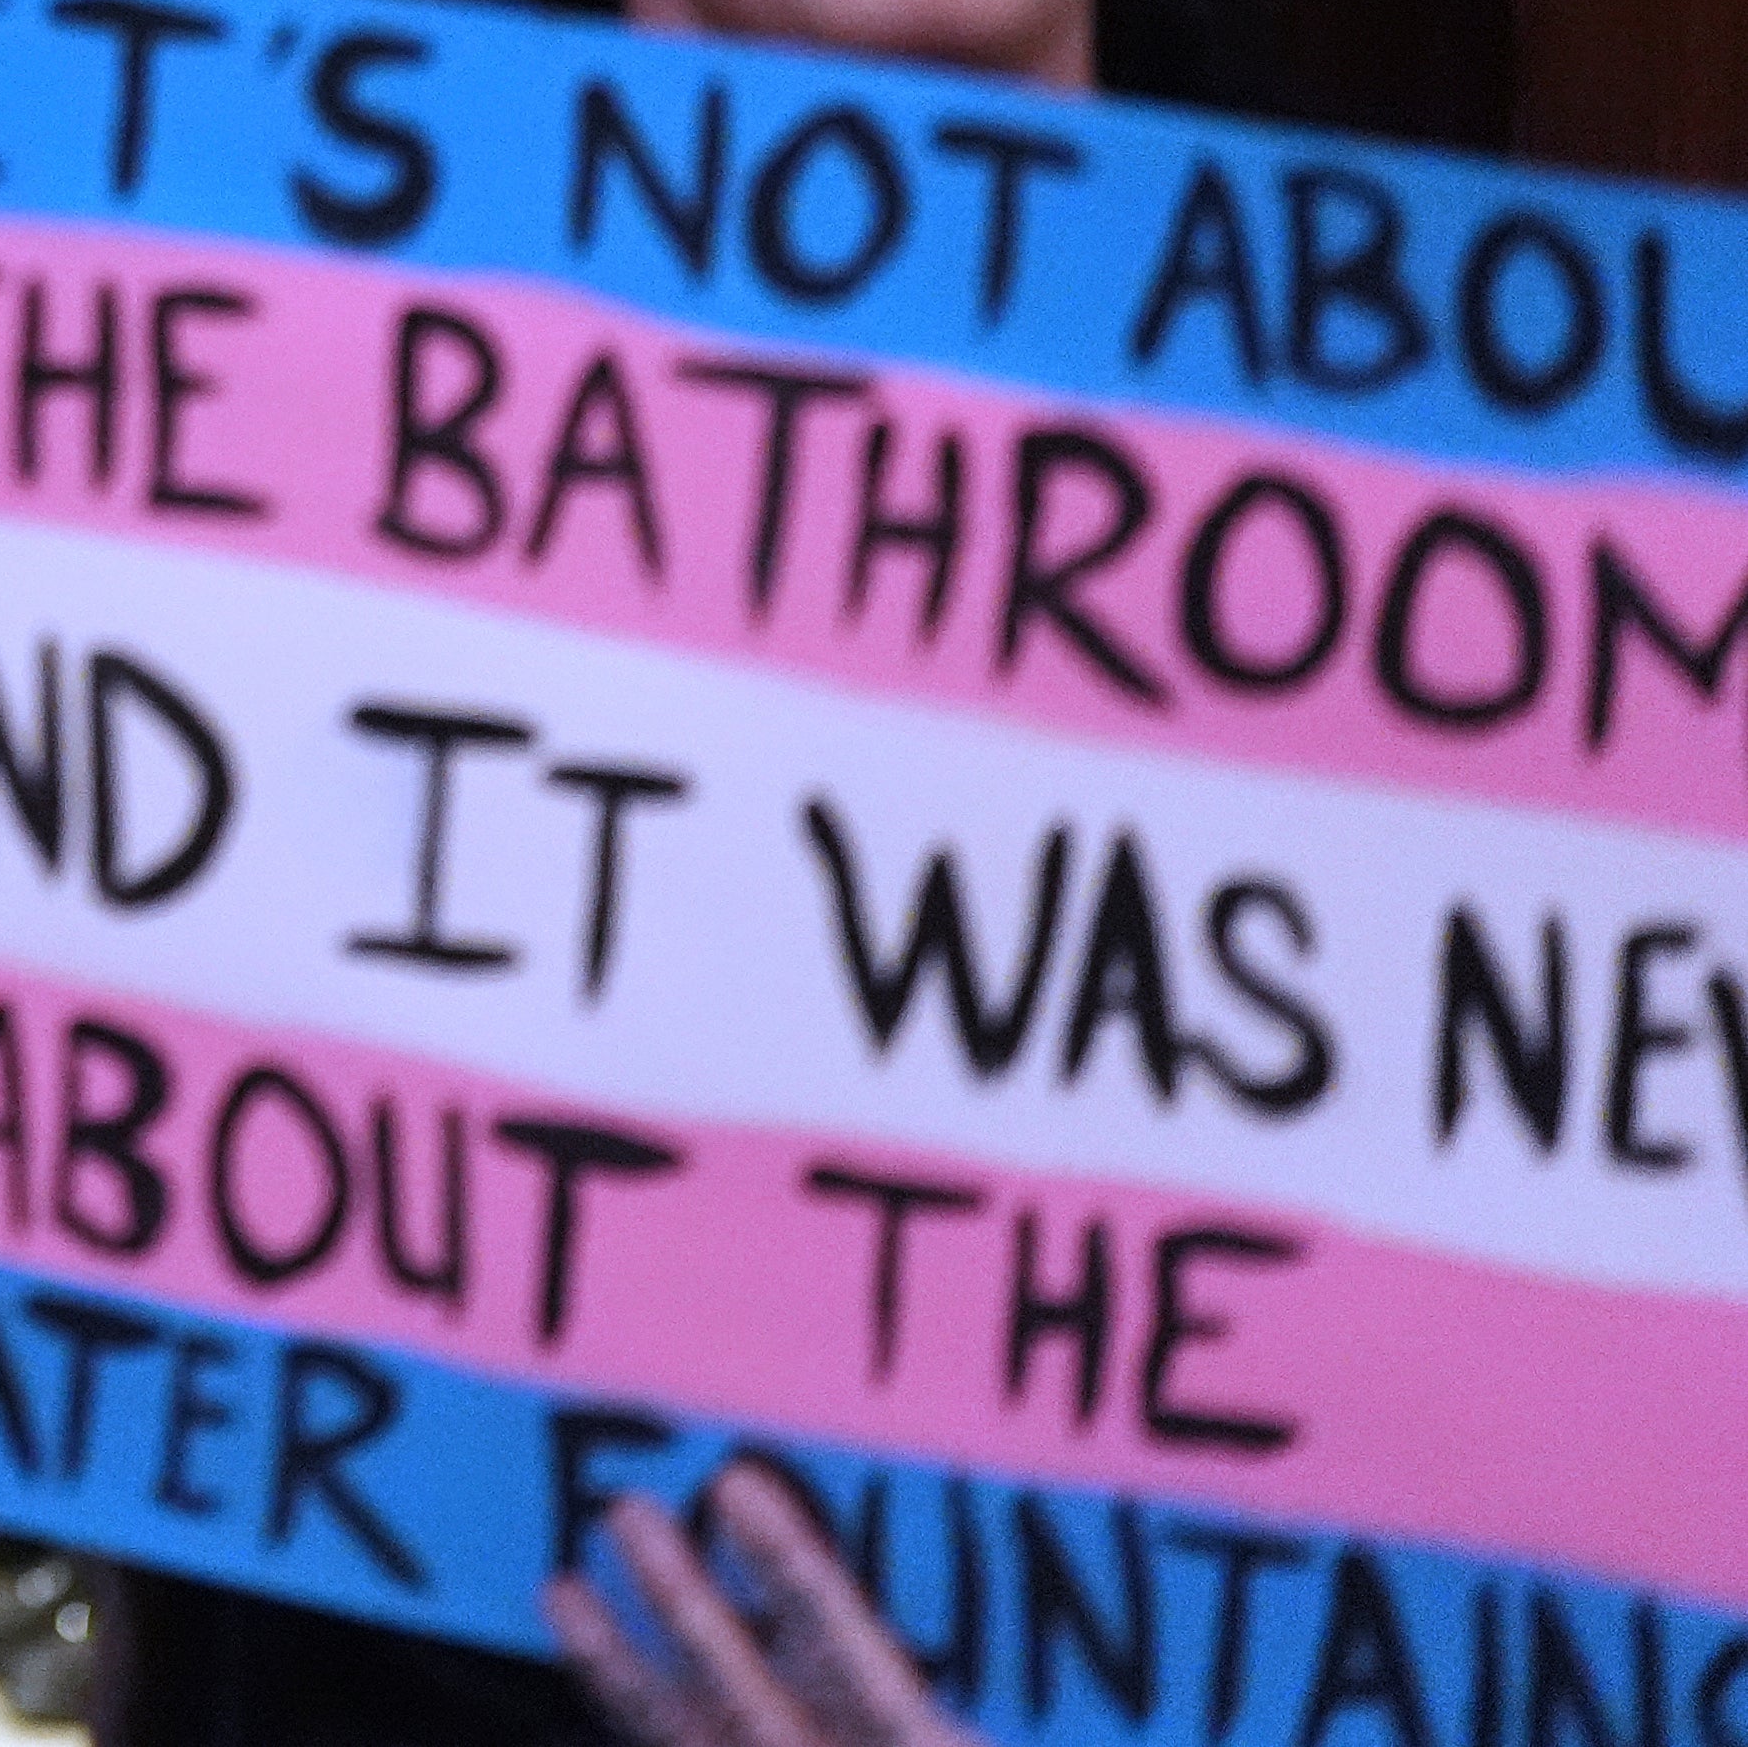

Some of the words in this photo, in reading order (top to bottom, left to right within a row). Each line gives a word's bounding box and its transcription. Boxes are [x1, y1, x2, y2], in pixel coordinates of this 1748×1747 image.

[565, 77, 1085, 314] NOT
[343, 700, 695, 1004] IT
[799, 797, 1340, 1122] WAS
[799, 1157, 1305, 1460] THE
